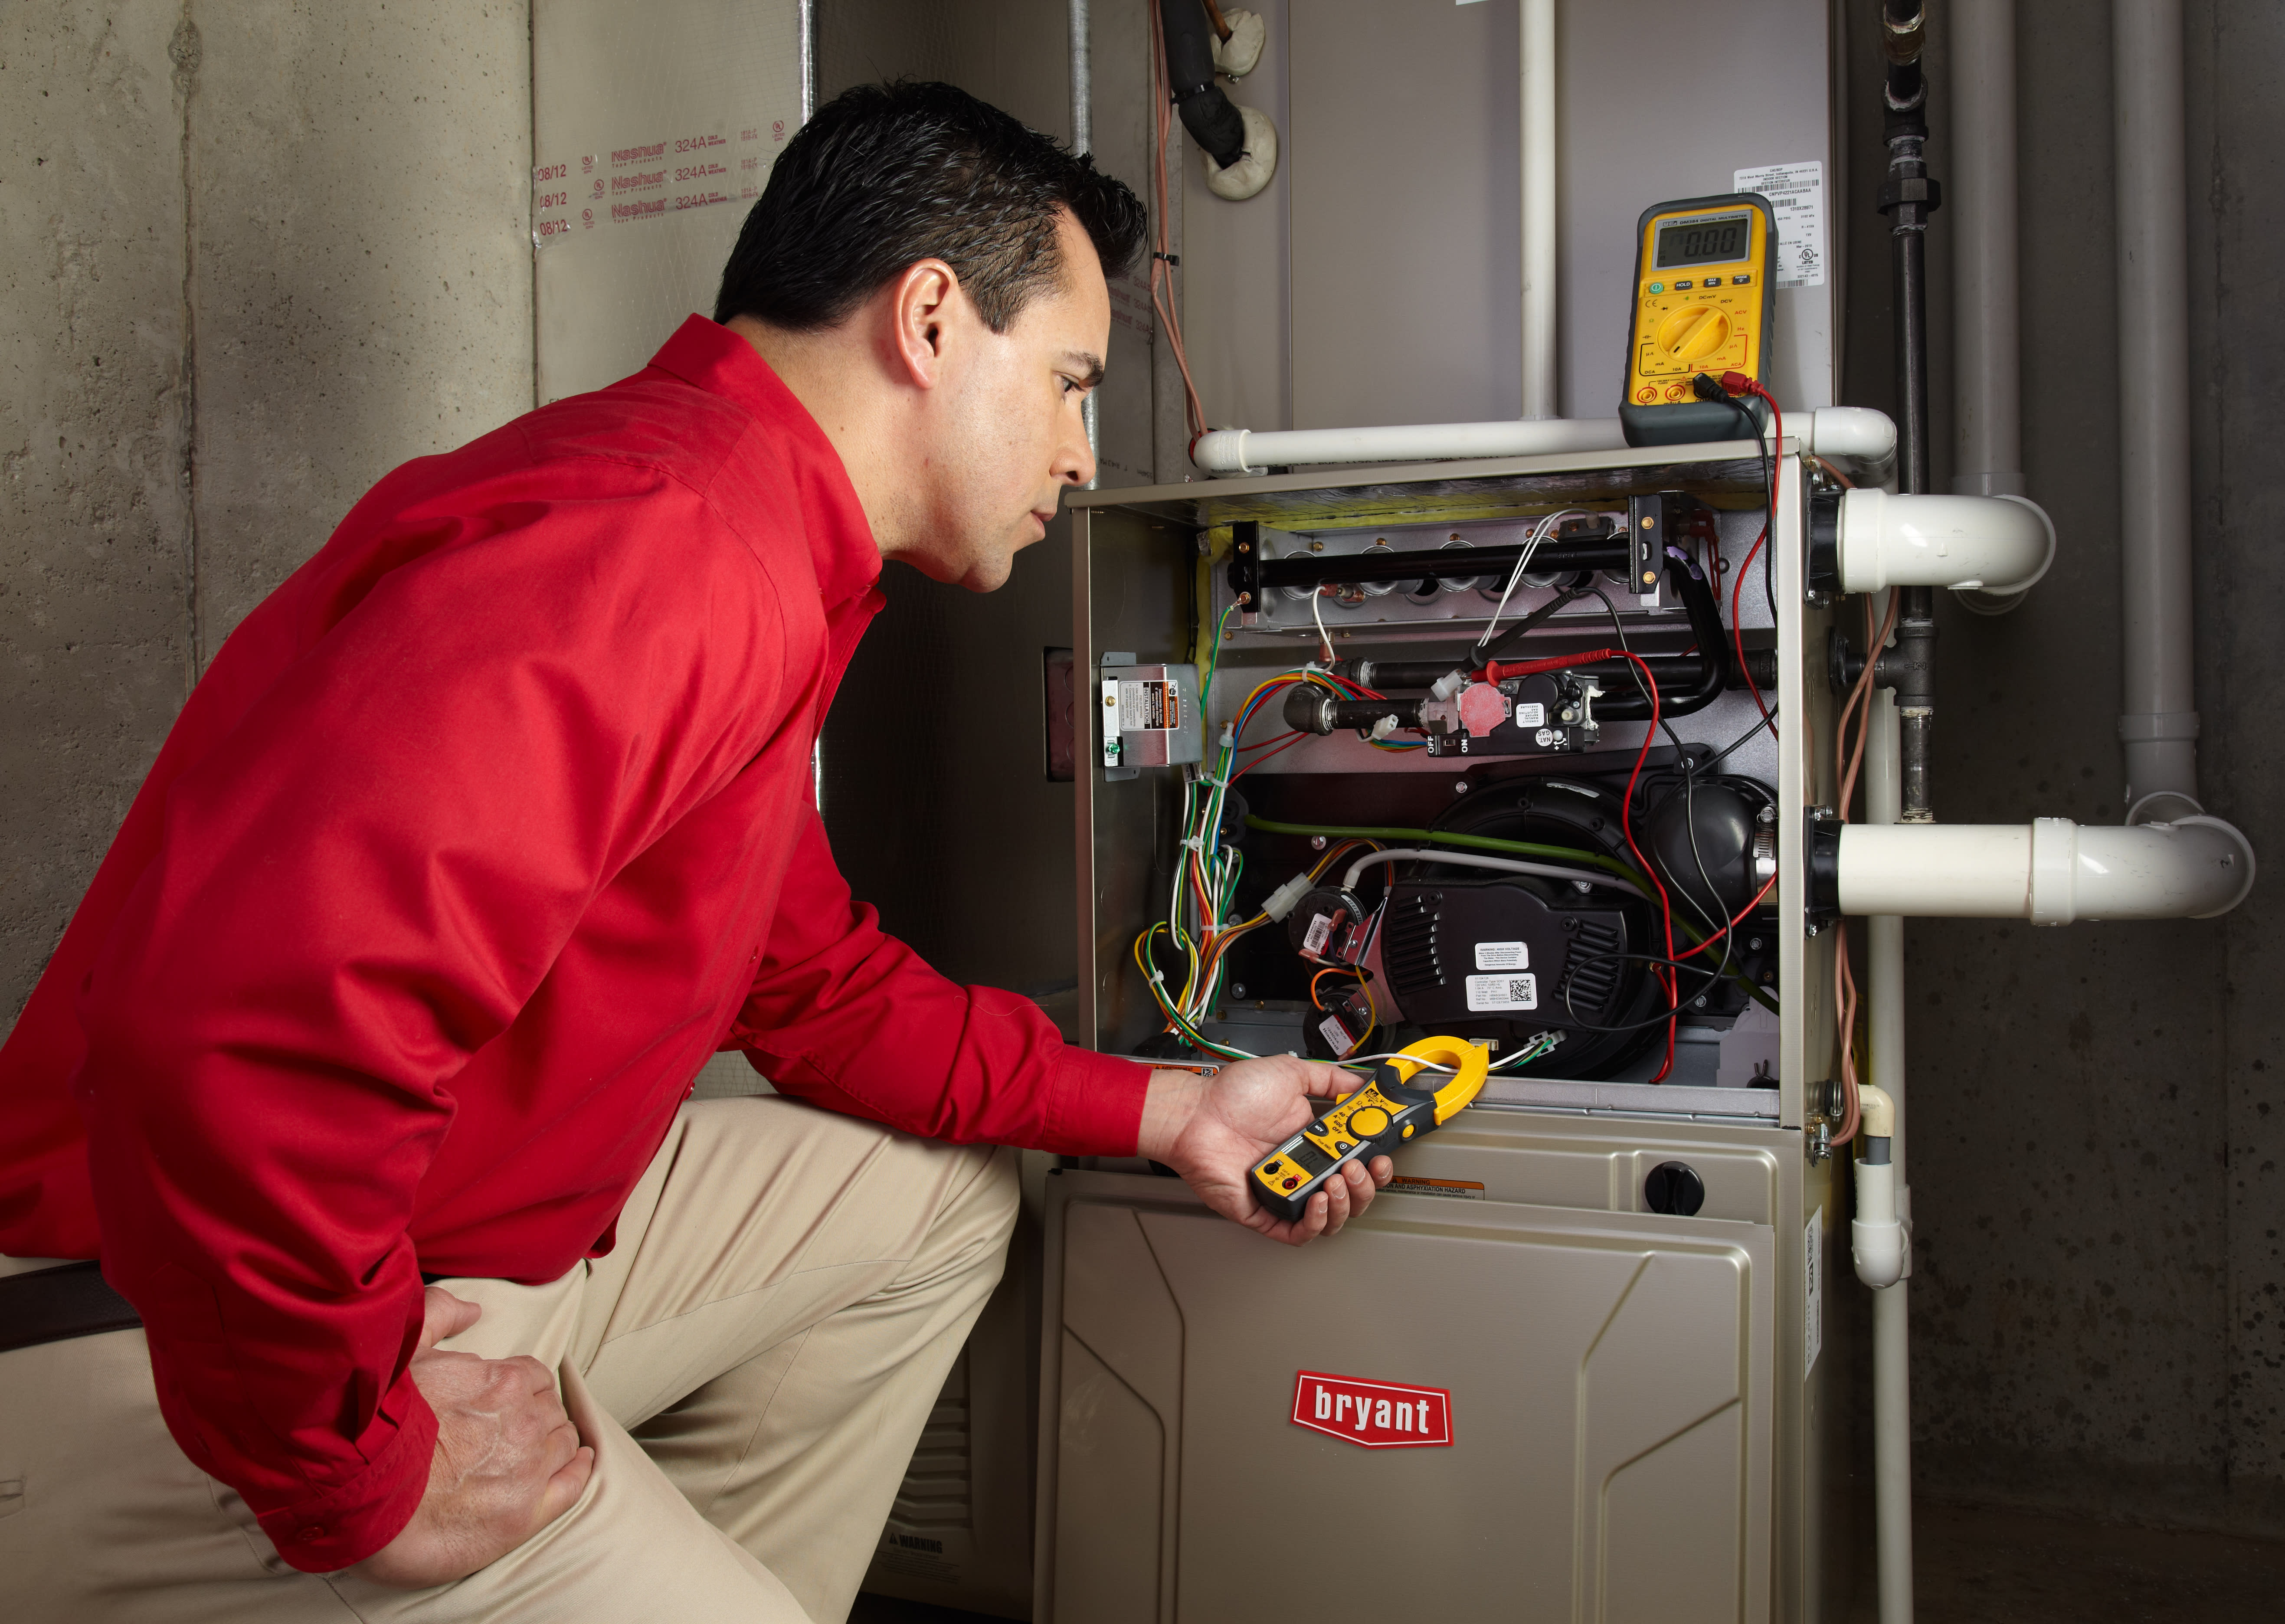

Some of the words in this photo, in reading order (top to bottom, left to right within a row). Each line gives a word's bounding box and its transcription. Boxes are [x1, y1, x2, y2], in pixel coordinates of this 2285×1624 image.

[675, 136, 707, 153] 324A
[632, 156, 663, 165] Products
[538, 164, 566, 181] 08/12
[675, 165, 707, 181] 324A
[632, 184, 662, 193] Products
[540, 192, 566, 209] 08/12
[676, 193, 708, 210] 324A
[634, 213, 664, 221] Products
[540, 219, 567, 236] 08/12
[1461, 739, 1468, 753] ON
[1306, 920, 1317, 942] Honeywell
[1323, 1028, 1339, 1050] Honeywell
[1315, 1385, 1429, 1434] bryant
[898, 1534, 943, 1554] WARNING
